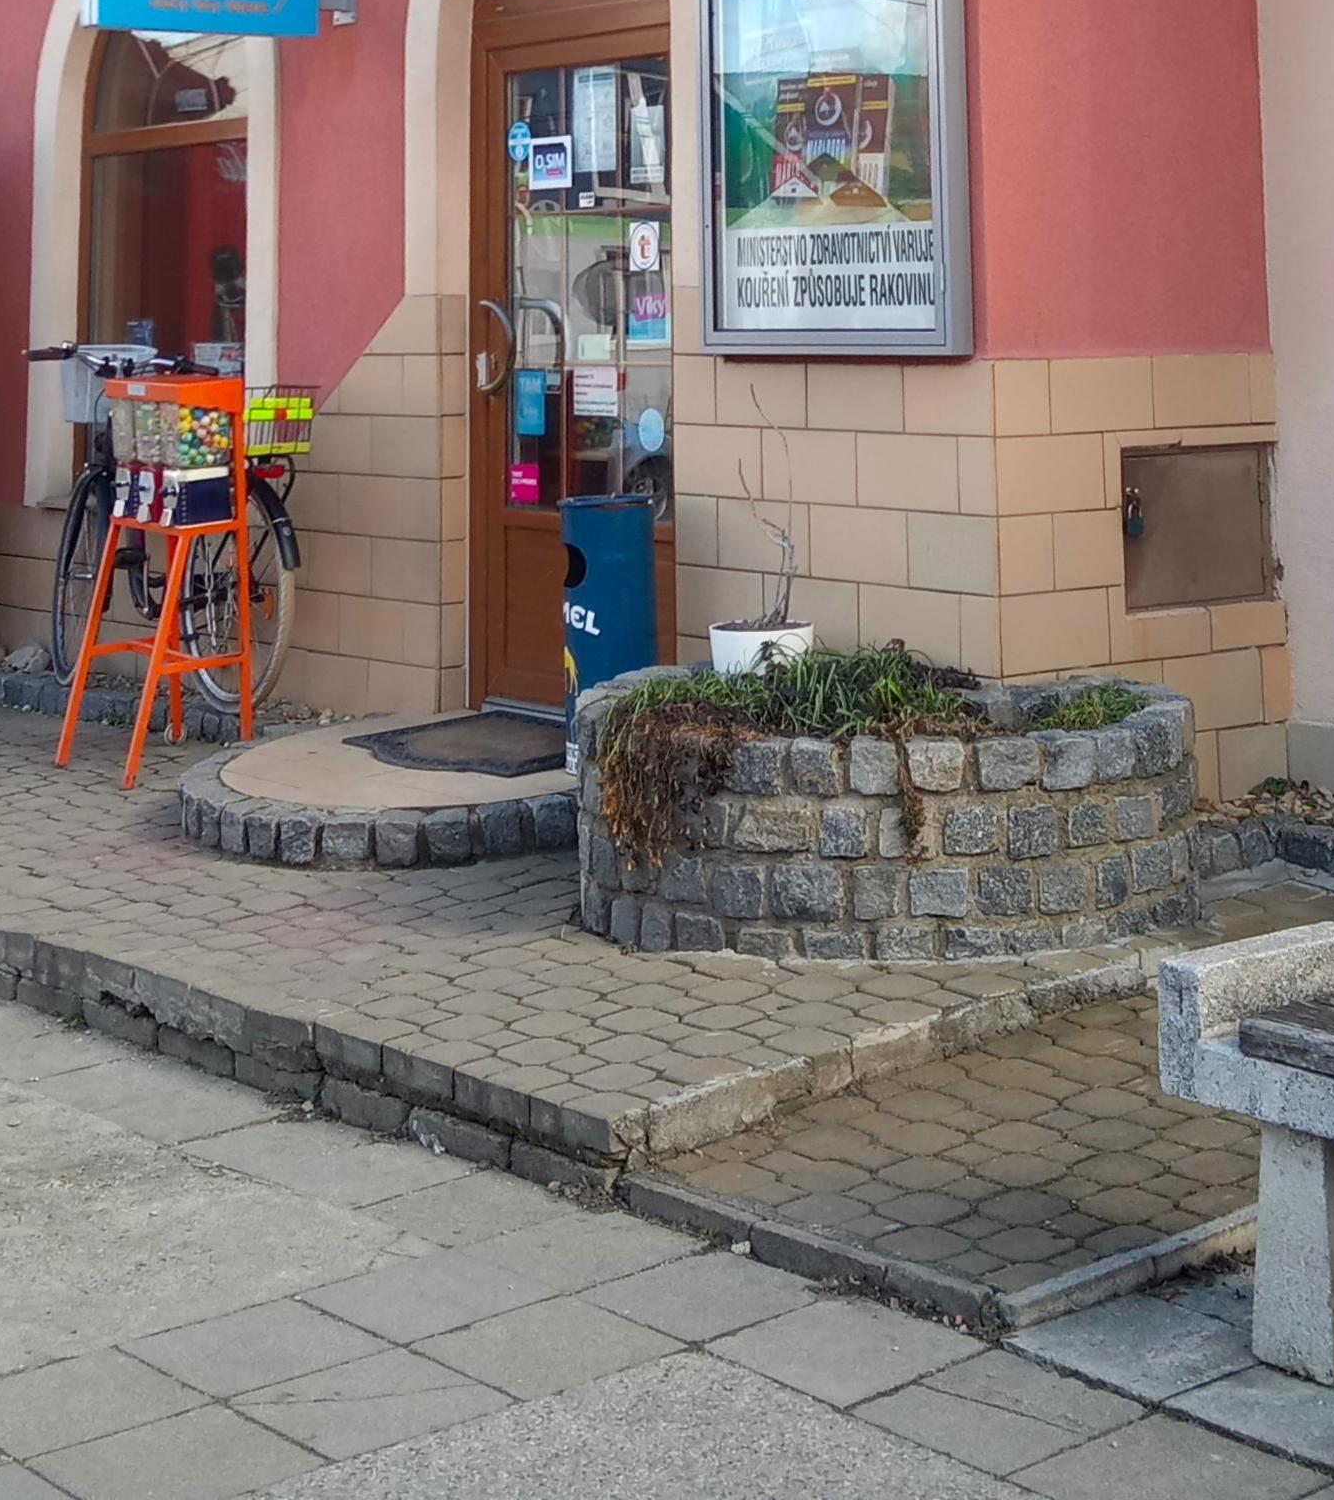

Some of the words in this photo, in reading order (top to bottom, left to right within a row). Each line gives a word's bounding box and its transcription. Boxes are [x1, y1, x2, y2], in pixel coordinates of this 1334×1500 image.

[737, 234, 807, 267] MINISTERSTVO
[809, 225, 892, 266] ZDRAVOTNICTVÍ
[737, 269, 789, 308] KOUŘENÍ
[793, 268, 866, 308] ZPŮSOBUJE
[870, 272, 935, 307] RAKOVINU
